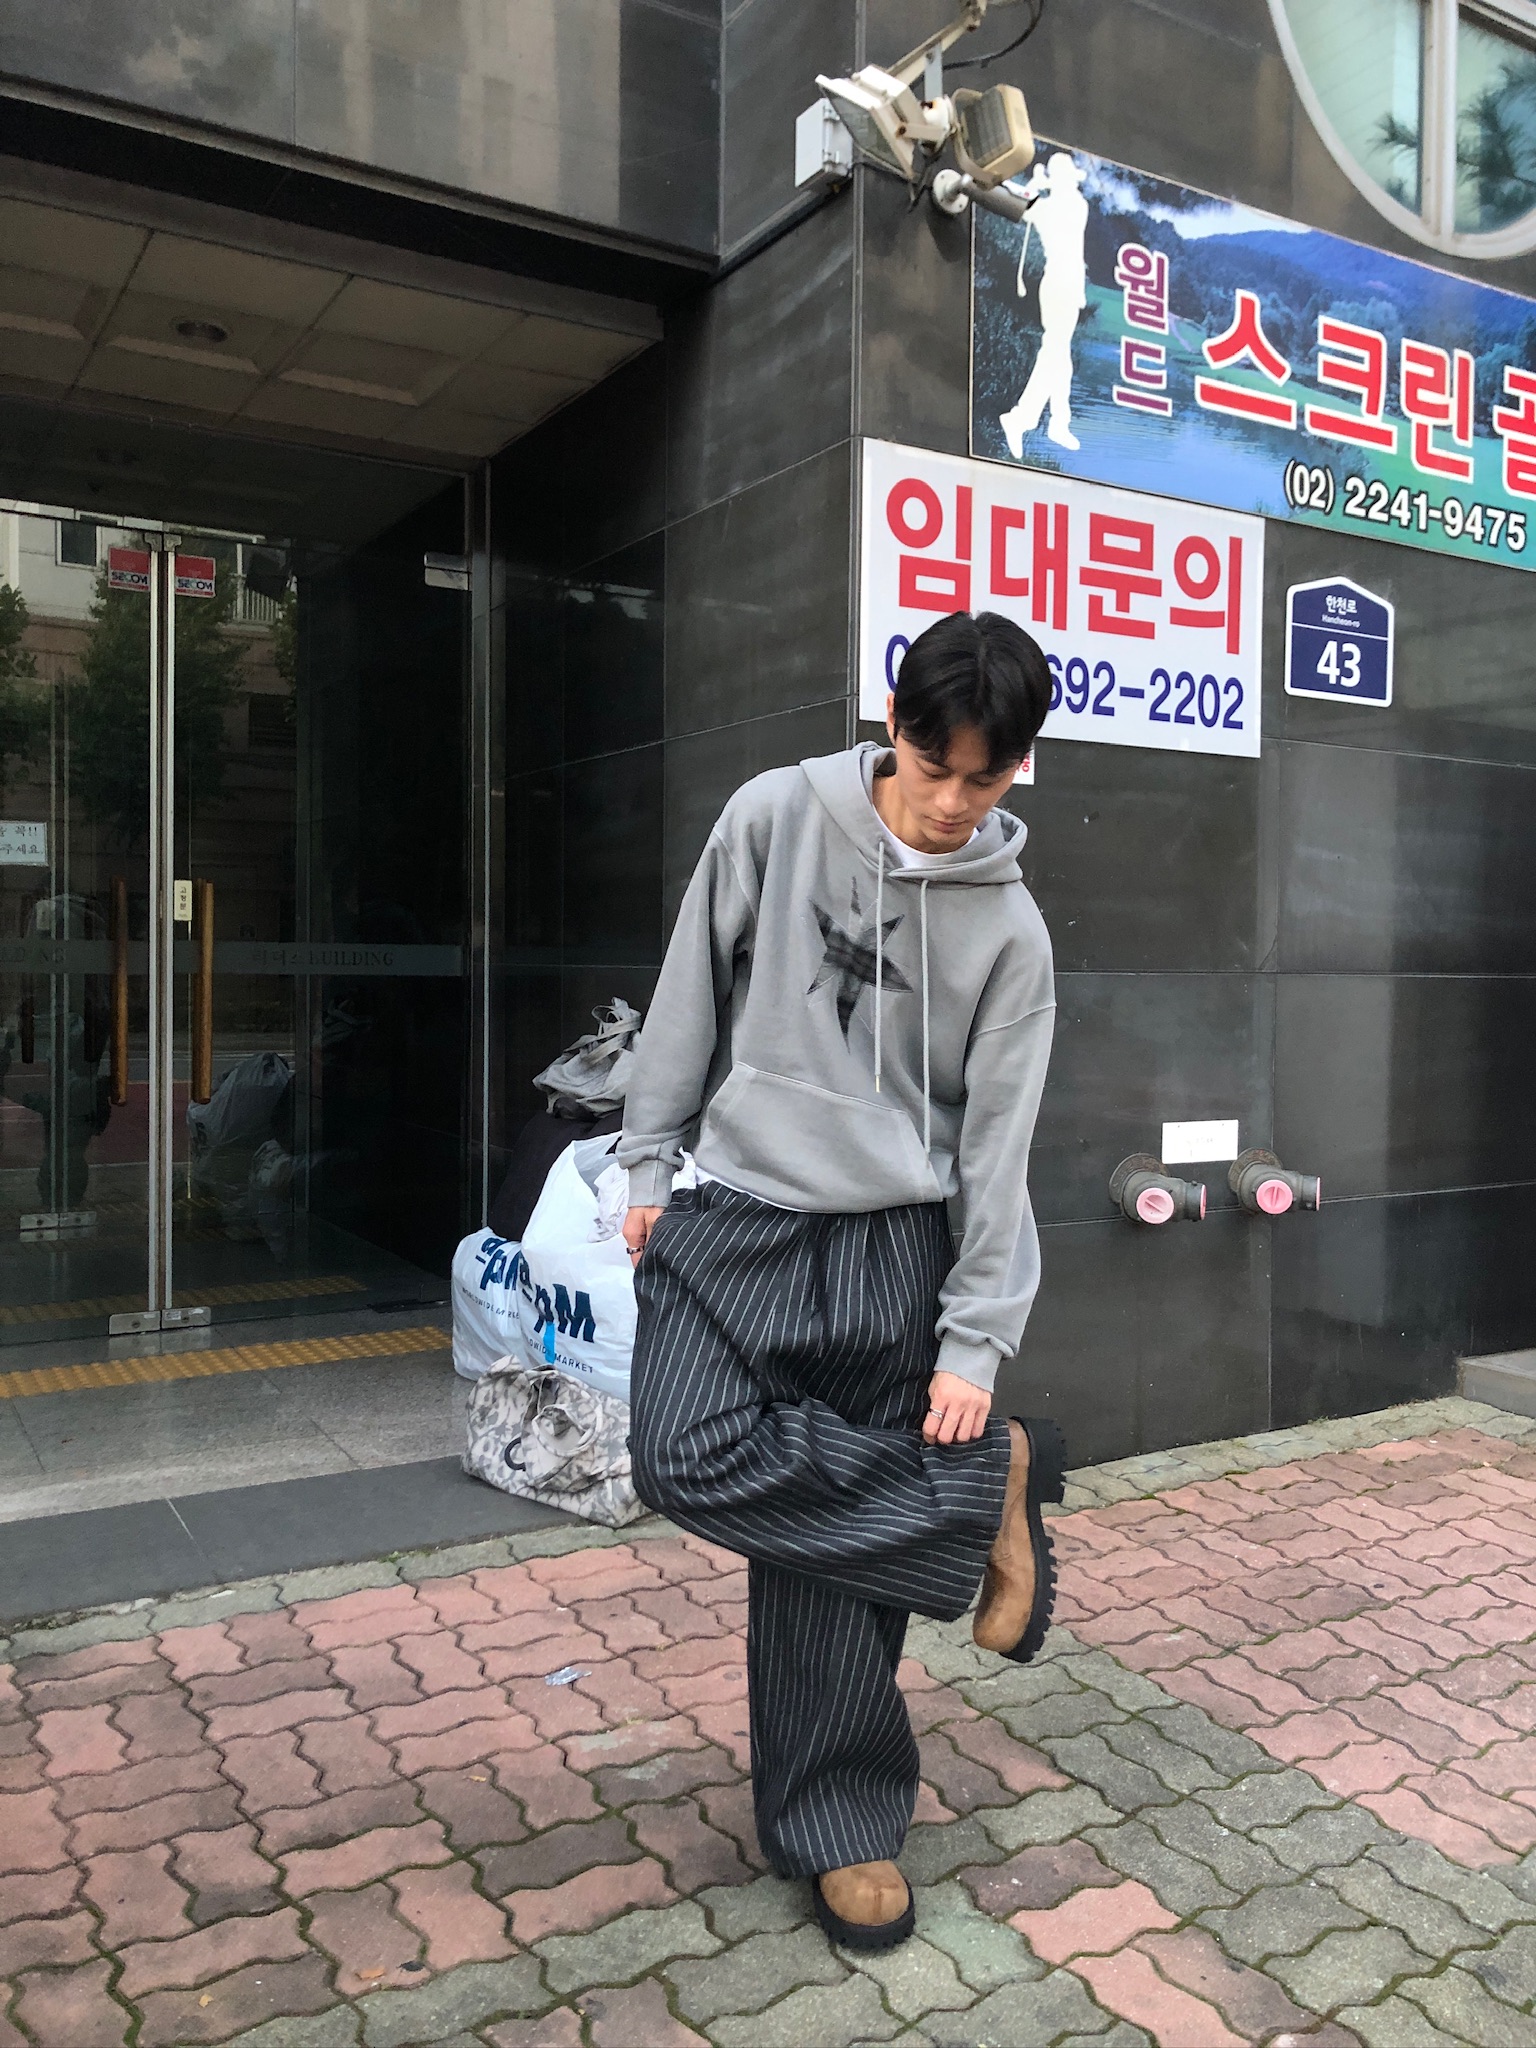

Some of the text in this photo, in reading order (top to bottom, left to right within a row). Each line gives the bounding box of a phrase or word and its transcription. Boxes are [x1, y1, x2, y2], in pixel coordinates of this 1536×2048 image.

[1115, 242, 1172, 417] 월드
[1284, 459, 1528, 553] (02) 2241-9475
[111, 571, 148, 585] SECOM
[886, 478, 1242, 655] 임대문의
[178, 578, 213, 592] SECOM
[1325, 595, 1358, 615] 한천로
[1316, 640, 1361, 687] 43
[554, 1352, 594, 1373] MARKET
